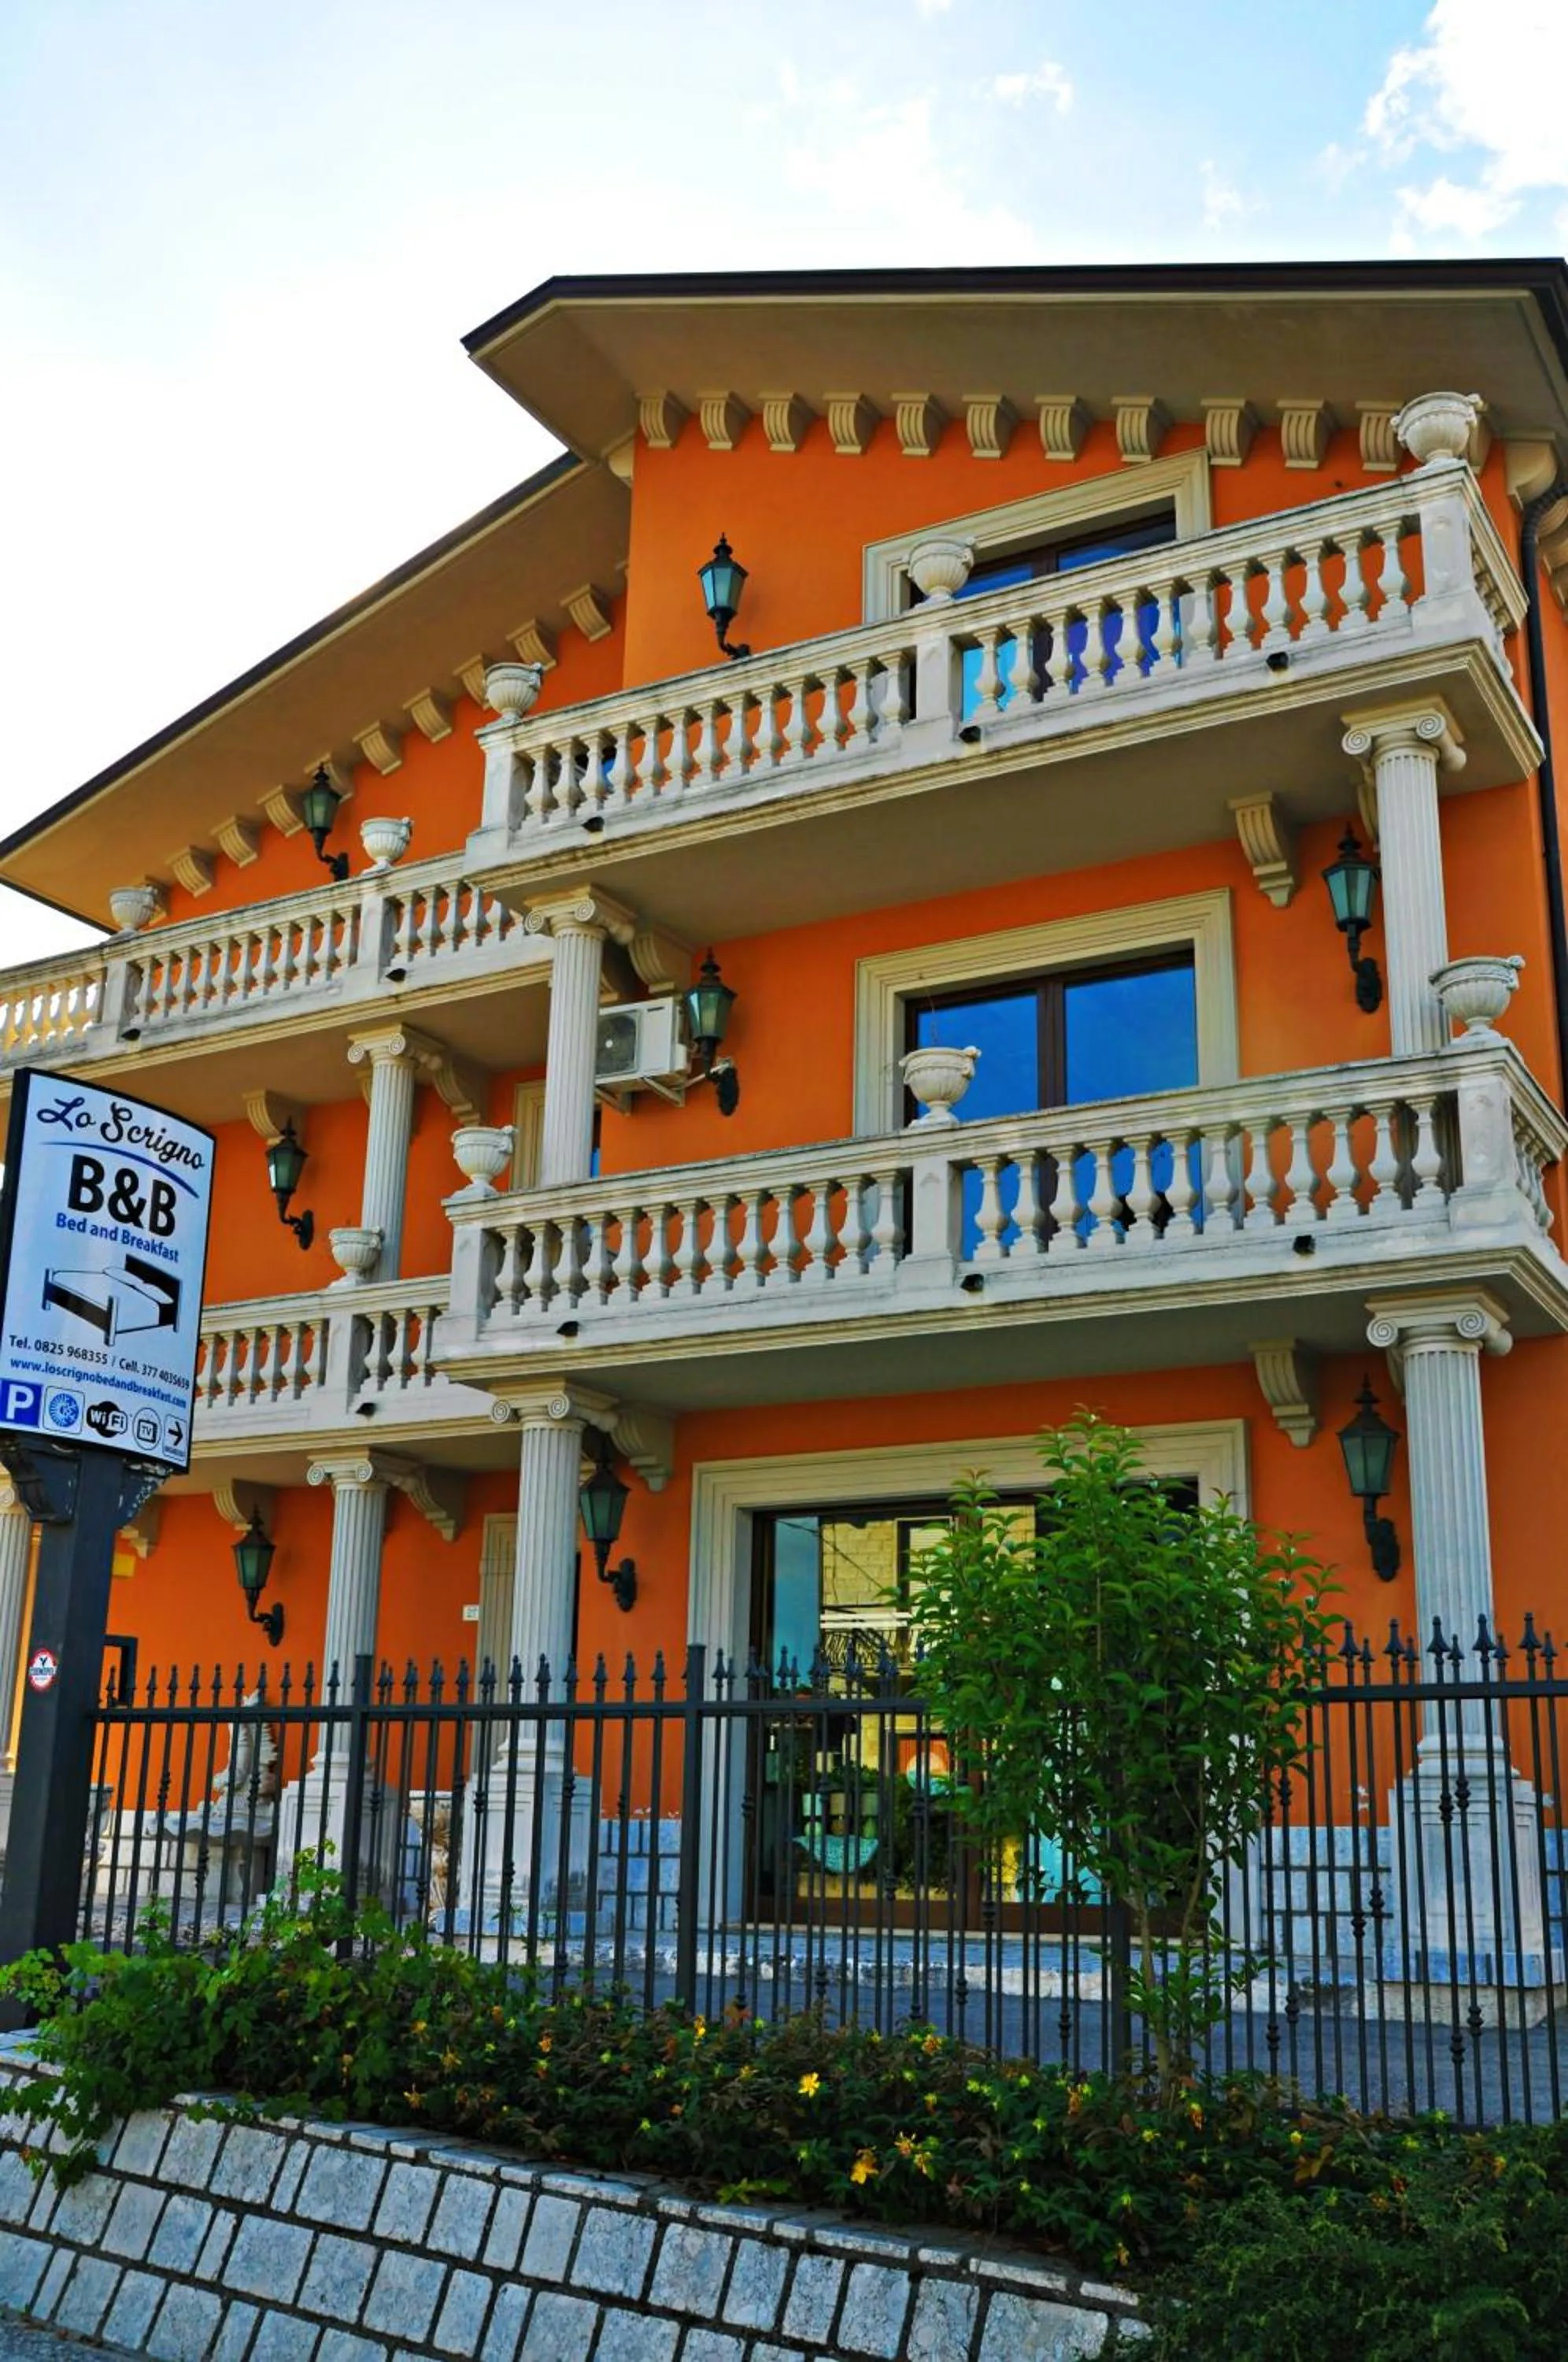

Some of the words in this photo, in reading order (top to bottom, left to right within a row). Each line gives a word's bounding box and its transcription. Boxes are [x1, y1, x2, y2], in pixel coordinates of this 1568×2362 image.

[100, 1101, 205, 1170] Scrigno
[68, 1153, 177, 1237] B&B
[56, 1212, 87, 1233] Bed
[90, 1224, 118, 1242] and
[120, 1229, 179, 1263] Breakfast
[9, 1335, 31, 1349] Tel.
[34, 1339, 64, 1355] 0825
[67, 1346, 108, 1364] 968355
[119, 1357, 139, 1373] Cell.
[142, 1363, 158, 1379] 377
[6, 1383, 35, 1420] P
[10, 1358, 187, 1409] www.loscrignobedandbreakfast.com
[142, 1426, 152, 1436] TV
